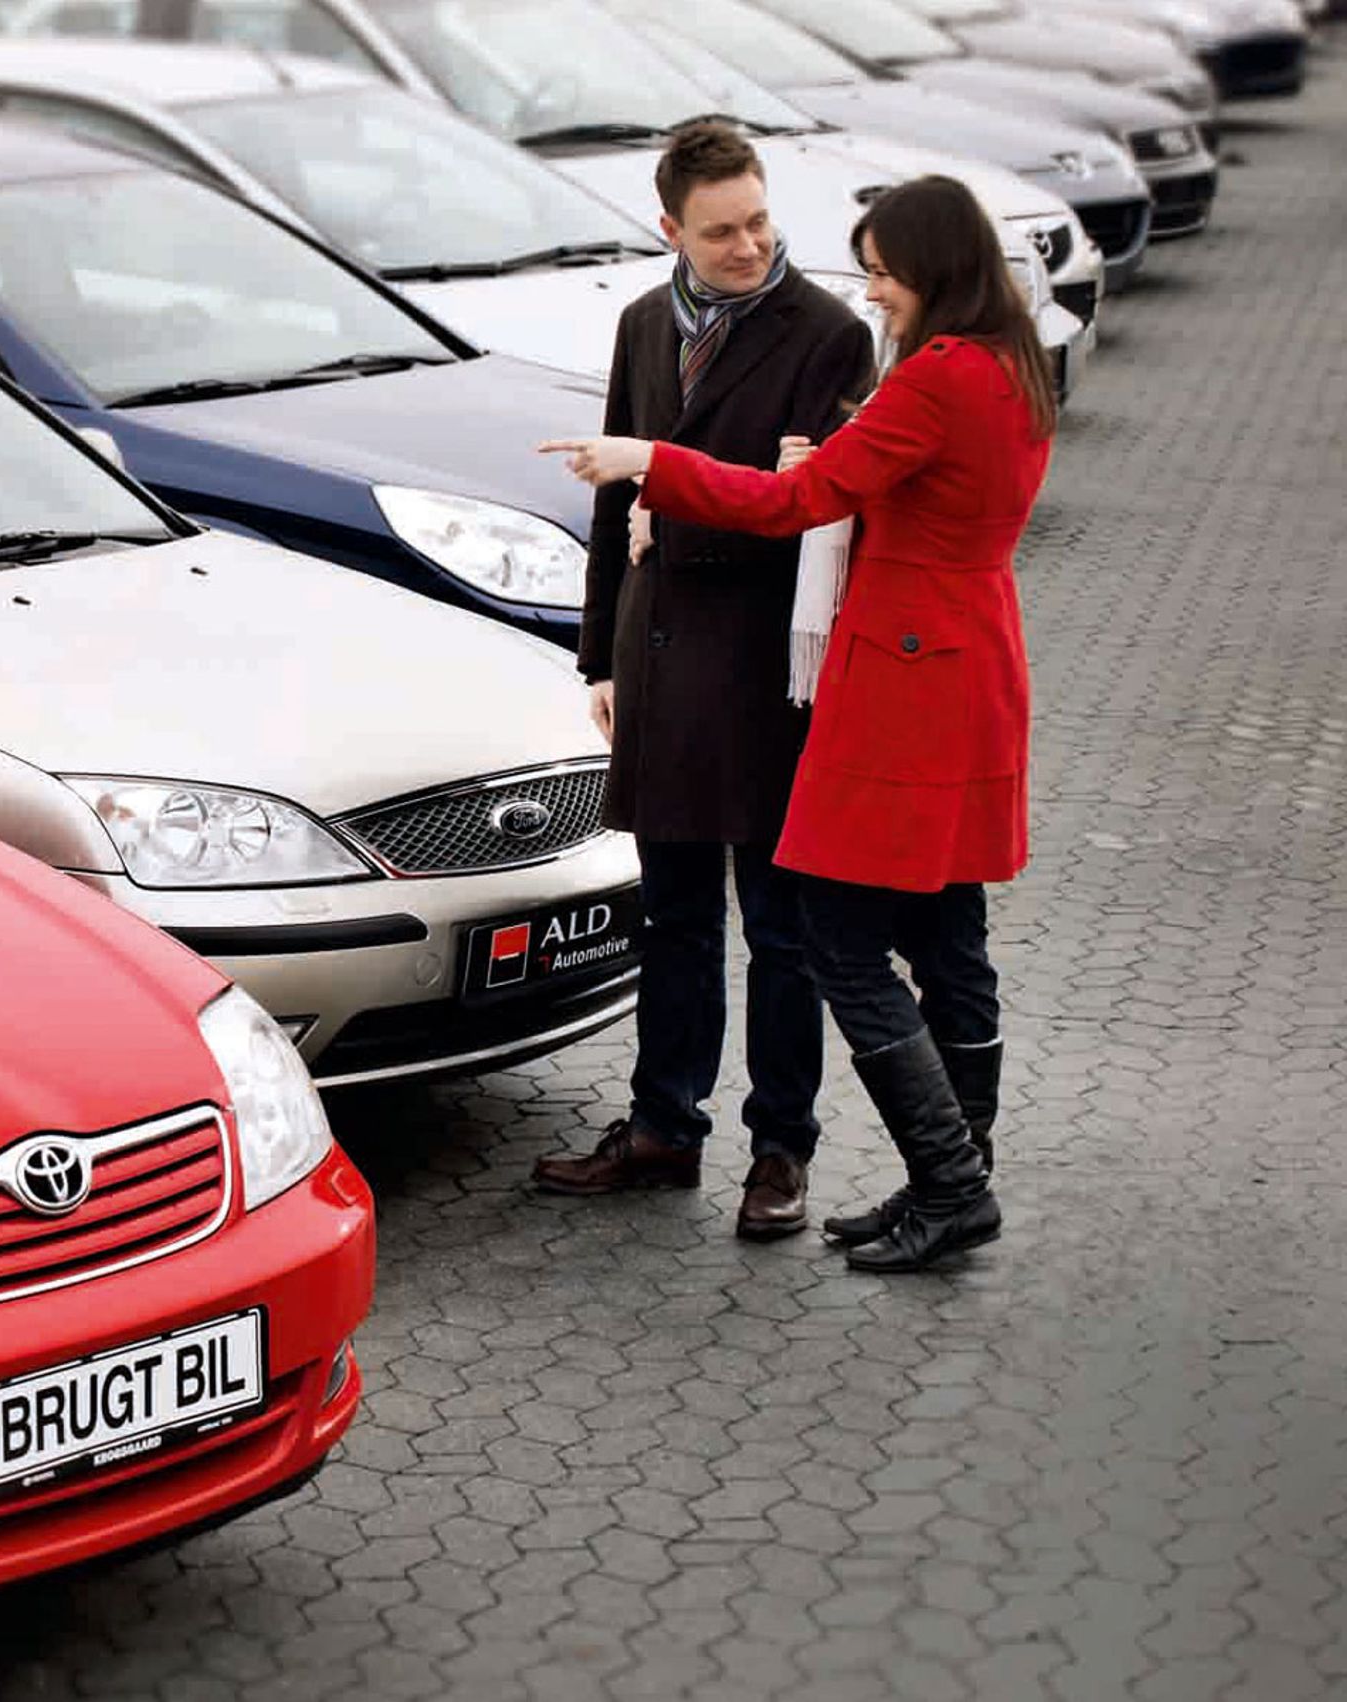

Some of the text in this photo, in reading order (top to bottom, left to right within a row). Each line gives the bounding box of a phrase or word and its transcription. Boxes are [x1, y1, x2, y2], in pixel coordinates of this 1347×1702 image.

[513, 808, 540, 829] Ford
[540, 904, 611, 948] ALD
[552, 936, 629, 971] Automotive
[2, 1336, 246, 1463] BRUGT BIL
